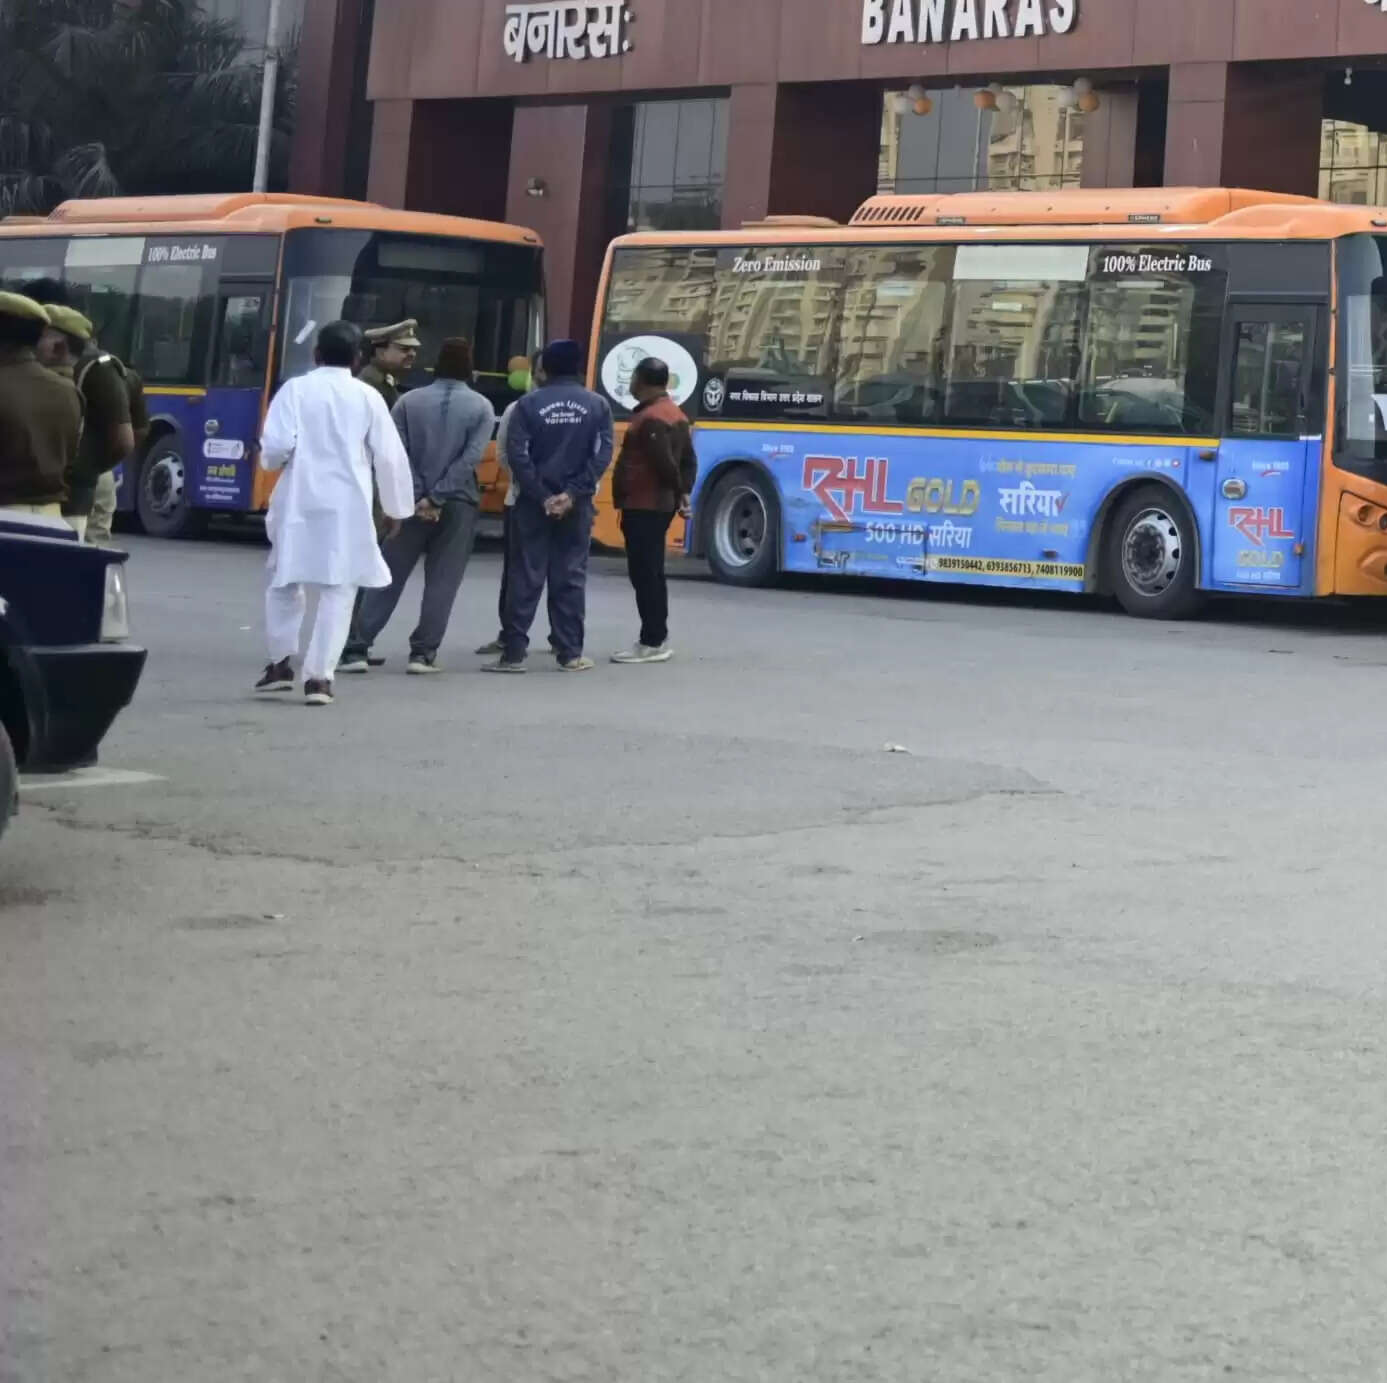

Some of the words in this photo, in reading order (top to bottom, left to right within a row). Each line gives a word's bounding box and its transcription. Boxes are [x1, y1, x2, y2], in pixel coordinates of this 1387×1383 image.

[732, 257, 761, 273] Zero
[763, 254, 821, 272] Emission
[1103, 256, 1135, 273] 100%
[1137, 254, 1186, 272] Electric
[1187, 255, 1212, 272] Bus
[906, 477, 982, 516] GOLD
[997, 479, 1063, 517] सरिया
[865, 520, 897, 543] 500
[899, 523, 925, 544] HD
[928, 520, 973, 549] सरिया
